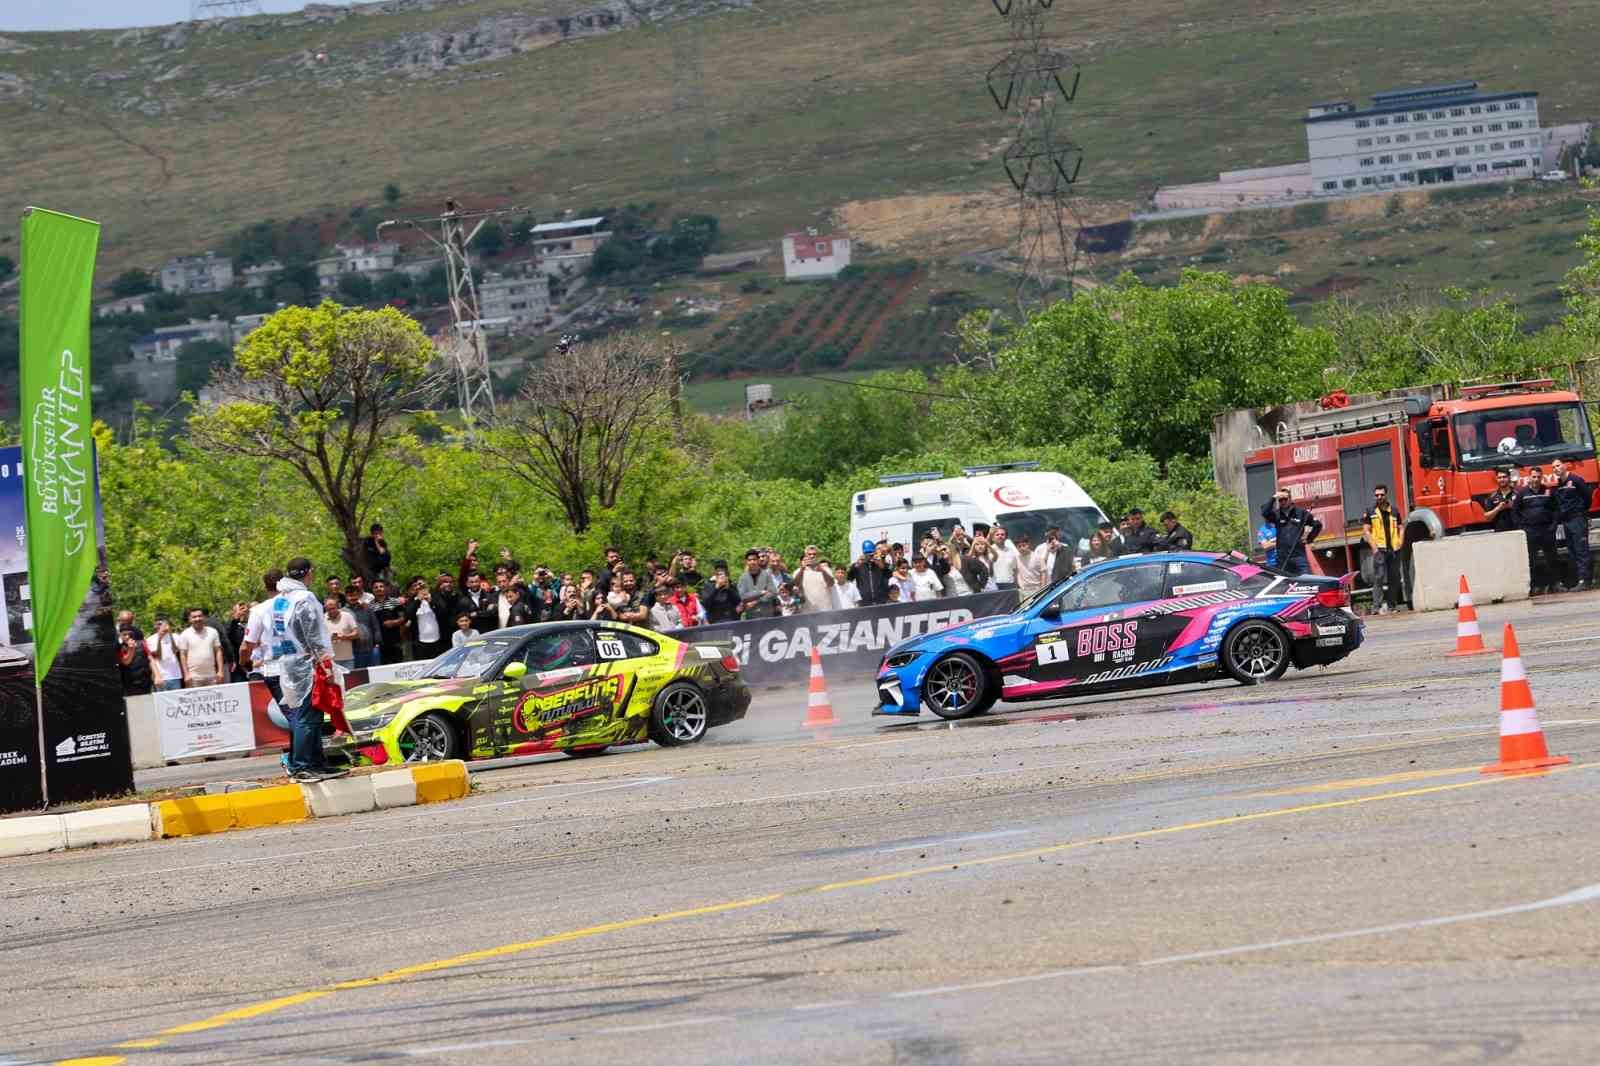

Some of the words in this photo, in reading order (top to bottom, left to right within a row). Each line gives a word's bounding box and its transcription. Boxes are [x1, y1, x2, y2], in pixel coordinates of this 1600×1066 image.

[1077, 621, 1138, 656] BOSS
[602, 642, 621, 656] 06
[1047, 645, 1057, 660] 1
